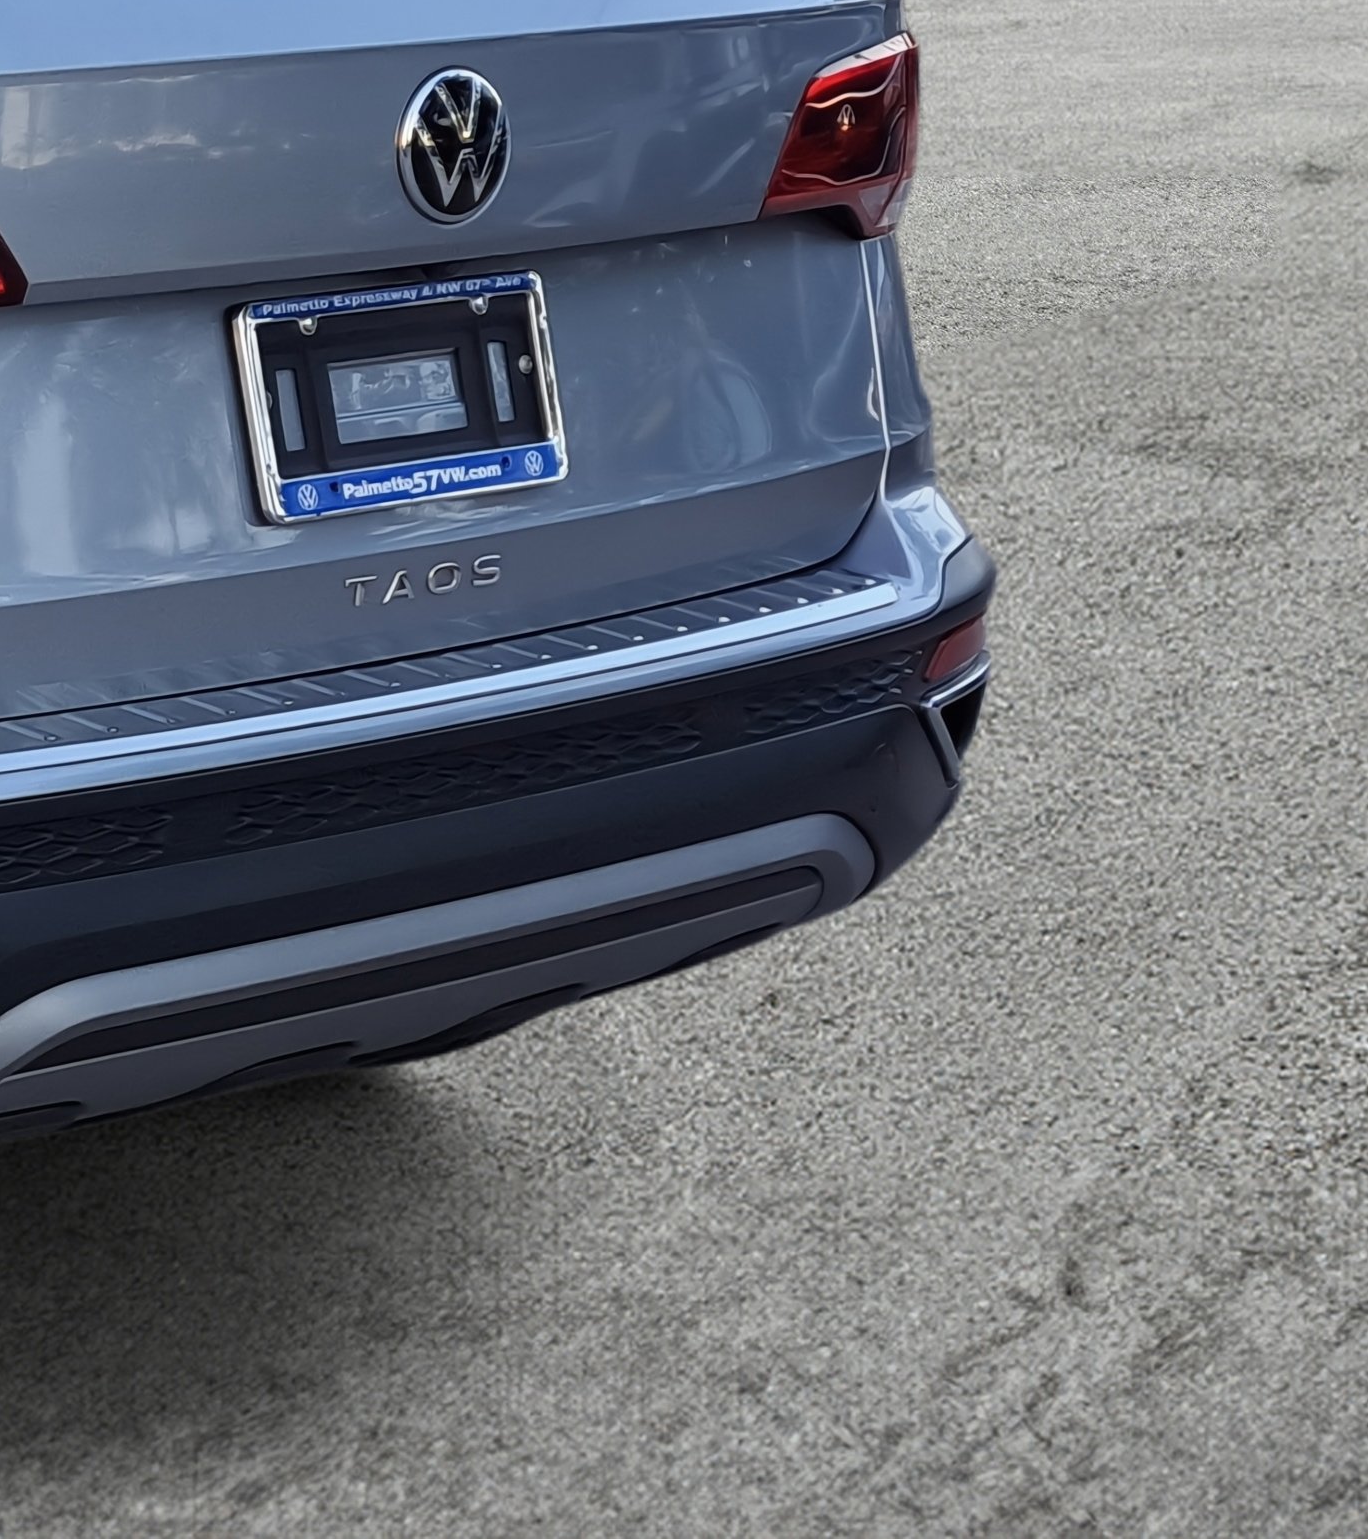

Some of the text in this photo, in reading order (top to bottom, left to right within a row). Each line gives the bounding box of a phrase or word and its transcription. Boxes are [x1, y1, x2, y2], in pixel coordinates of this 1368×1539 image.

[399, 69, 509, 223] VW
[262, 298, 329, 317] Palmetto
[333, 287, 419, 308] Expressway
[342, 463, 503, 500] Palmetto57VW.com
[344, 554, 502, 607] TAOS
